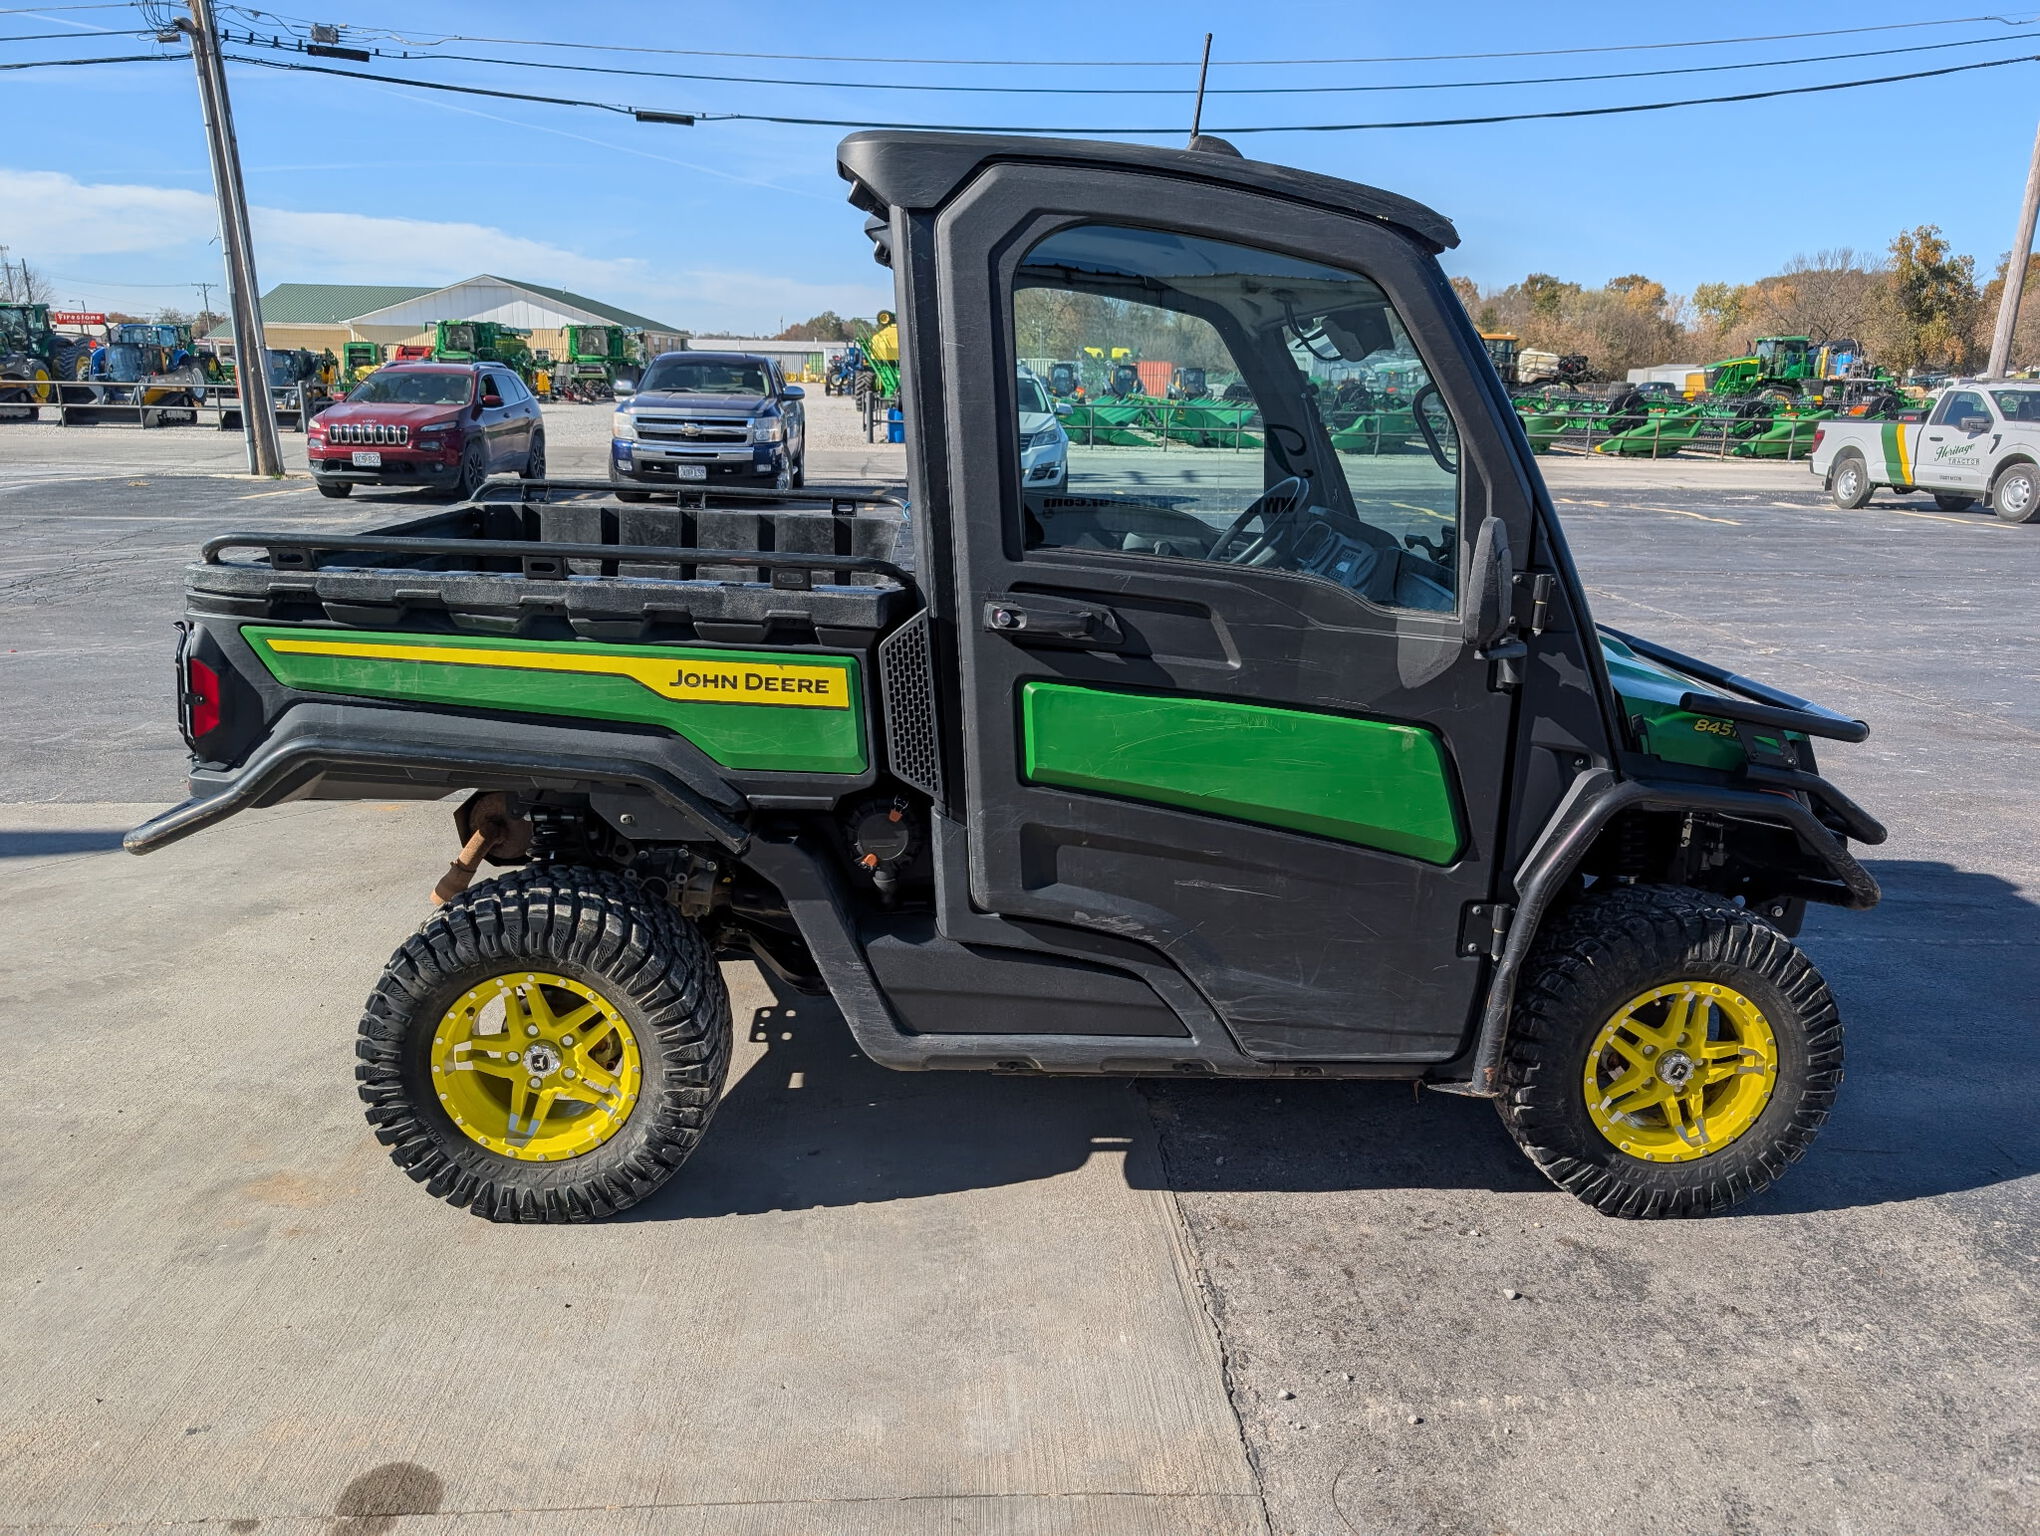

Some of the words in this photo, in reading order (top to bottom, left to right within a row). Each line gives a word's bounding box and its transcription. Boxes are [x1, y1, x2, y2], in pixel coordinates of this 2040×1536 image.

[57, 313, 101, 321] Firestone
[1933, 442, 1975, 462] Heritage
[1948, 457, 1980, 465] TRACTOR
[669, 669, 738, 690] JOHN
[744, 672, 830, 694] DEERE
